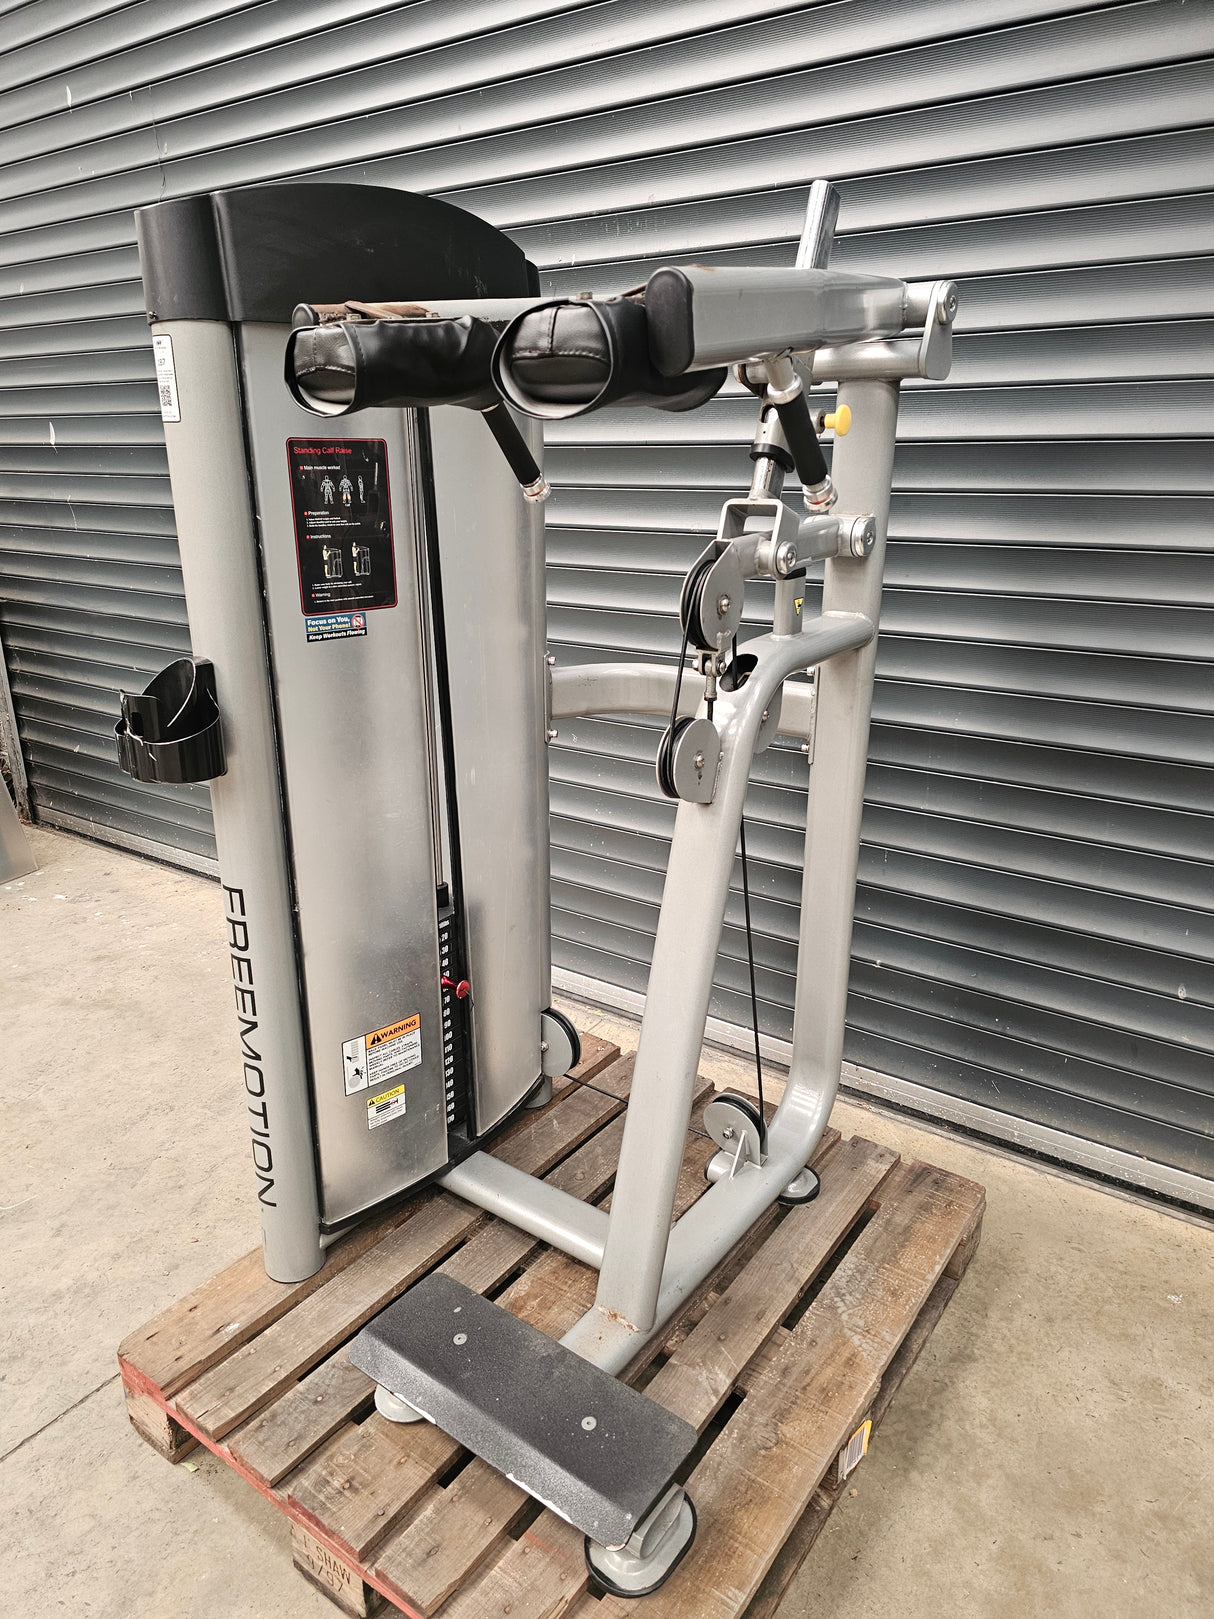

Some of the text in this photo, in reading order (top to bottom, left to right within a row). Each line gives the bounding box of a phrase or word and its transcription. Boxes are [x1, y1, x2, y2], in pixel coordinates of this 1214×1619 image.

[293, 446, 321, 455] Standing
[321, 446, 335, 454] Calf
[323, 631, 346, 639] Workouts
[347, 629, 365, 637] Flowing
[380, 1019, 417, 1039] WARNING
[223, 884, 277, 1208] FREEMOTION
[375, 1089, 400, 1103] CAUTION
[315, 1545, 351, 1585] SHAW
